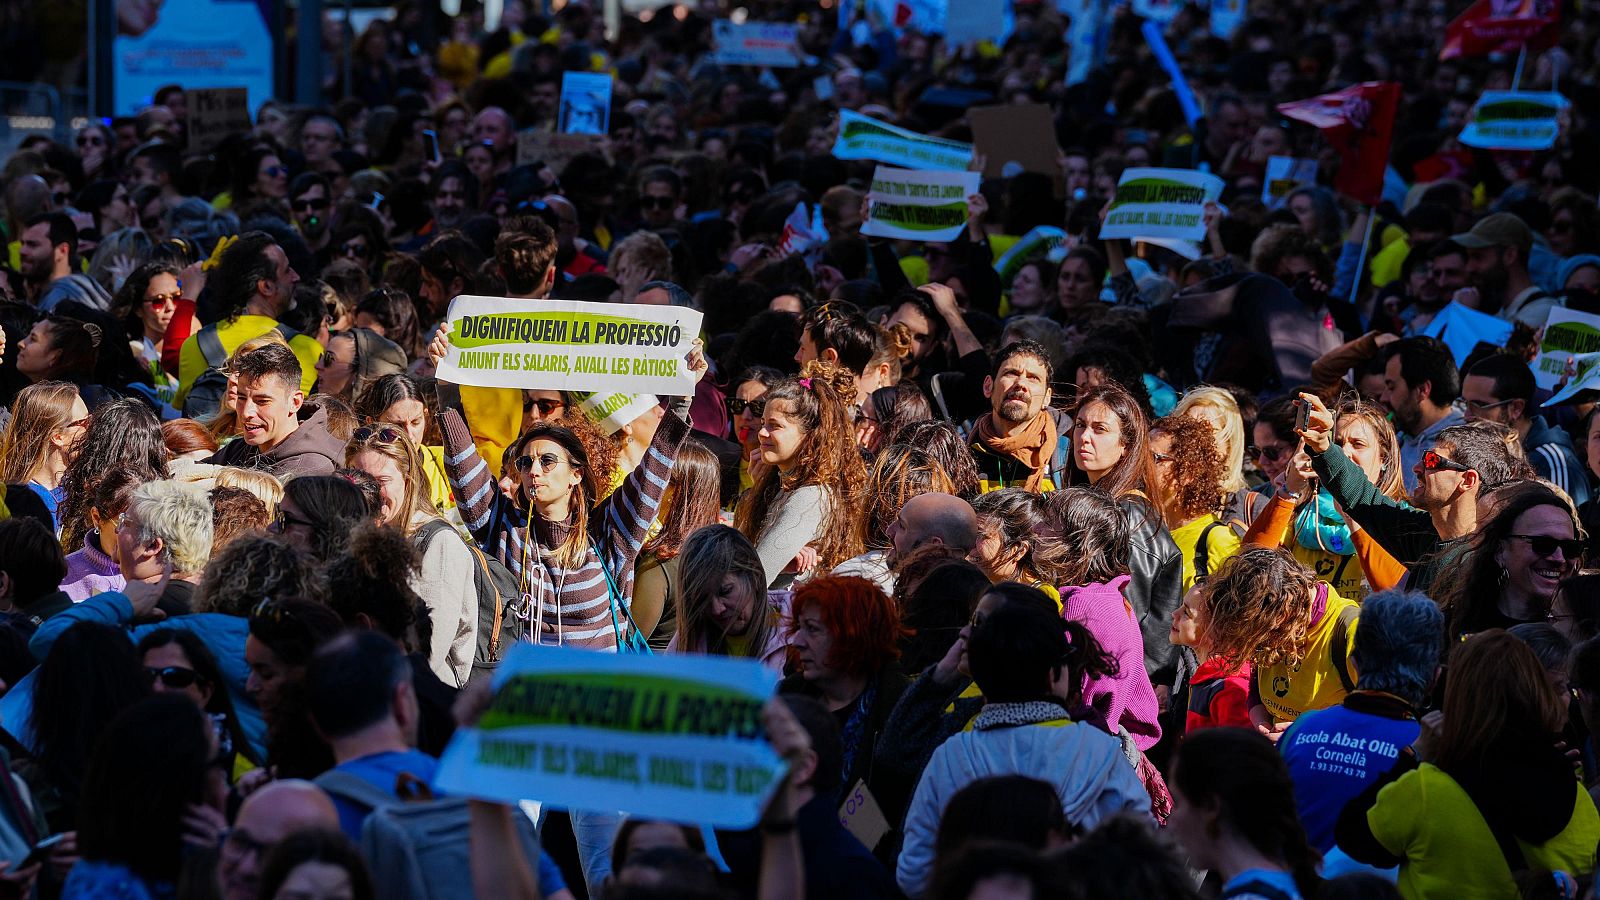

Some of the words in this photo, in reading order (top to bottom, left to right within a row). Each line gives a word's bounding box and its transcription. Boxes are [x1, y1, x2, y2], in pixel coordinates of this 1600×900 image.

[460, 315, 568, 344] DIGNIFIQUEM
[570, 321, 589, 344] LA
[594, 319, 681, 348] PROFESSIÓ
[458, 351, 499, 370] AMUNT
[502, 352, 521, 371] ELS
[523, 354, 571, 376] SALARIS,
[574, 356, 608, 375] AVALL
[611, 358, 630, 376] LES
[632, 354, 678, 378] RÀTIOS!
[676, 693, 768, 740] PROFES
[1295, 730, 1329, 745] Escola
[1331, 732, 1367, 750] Abat
[1368, 740, 1399, 759] Olib
[1316, 746, 1367, 767] Cornellà
[1317, 762, 1327, 772] 93
[1329, 764, 1342, 774] 377
[1344, 766, 1354, 777] 43
[1355, 769, 1366, 780] 78
